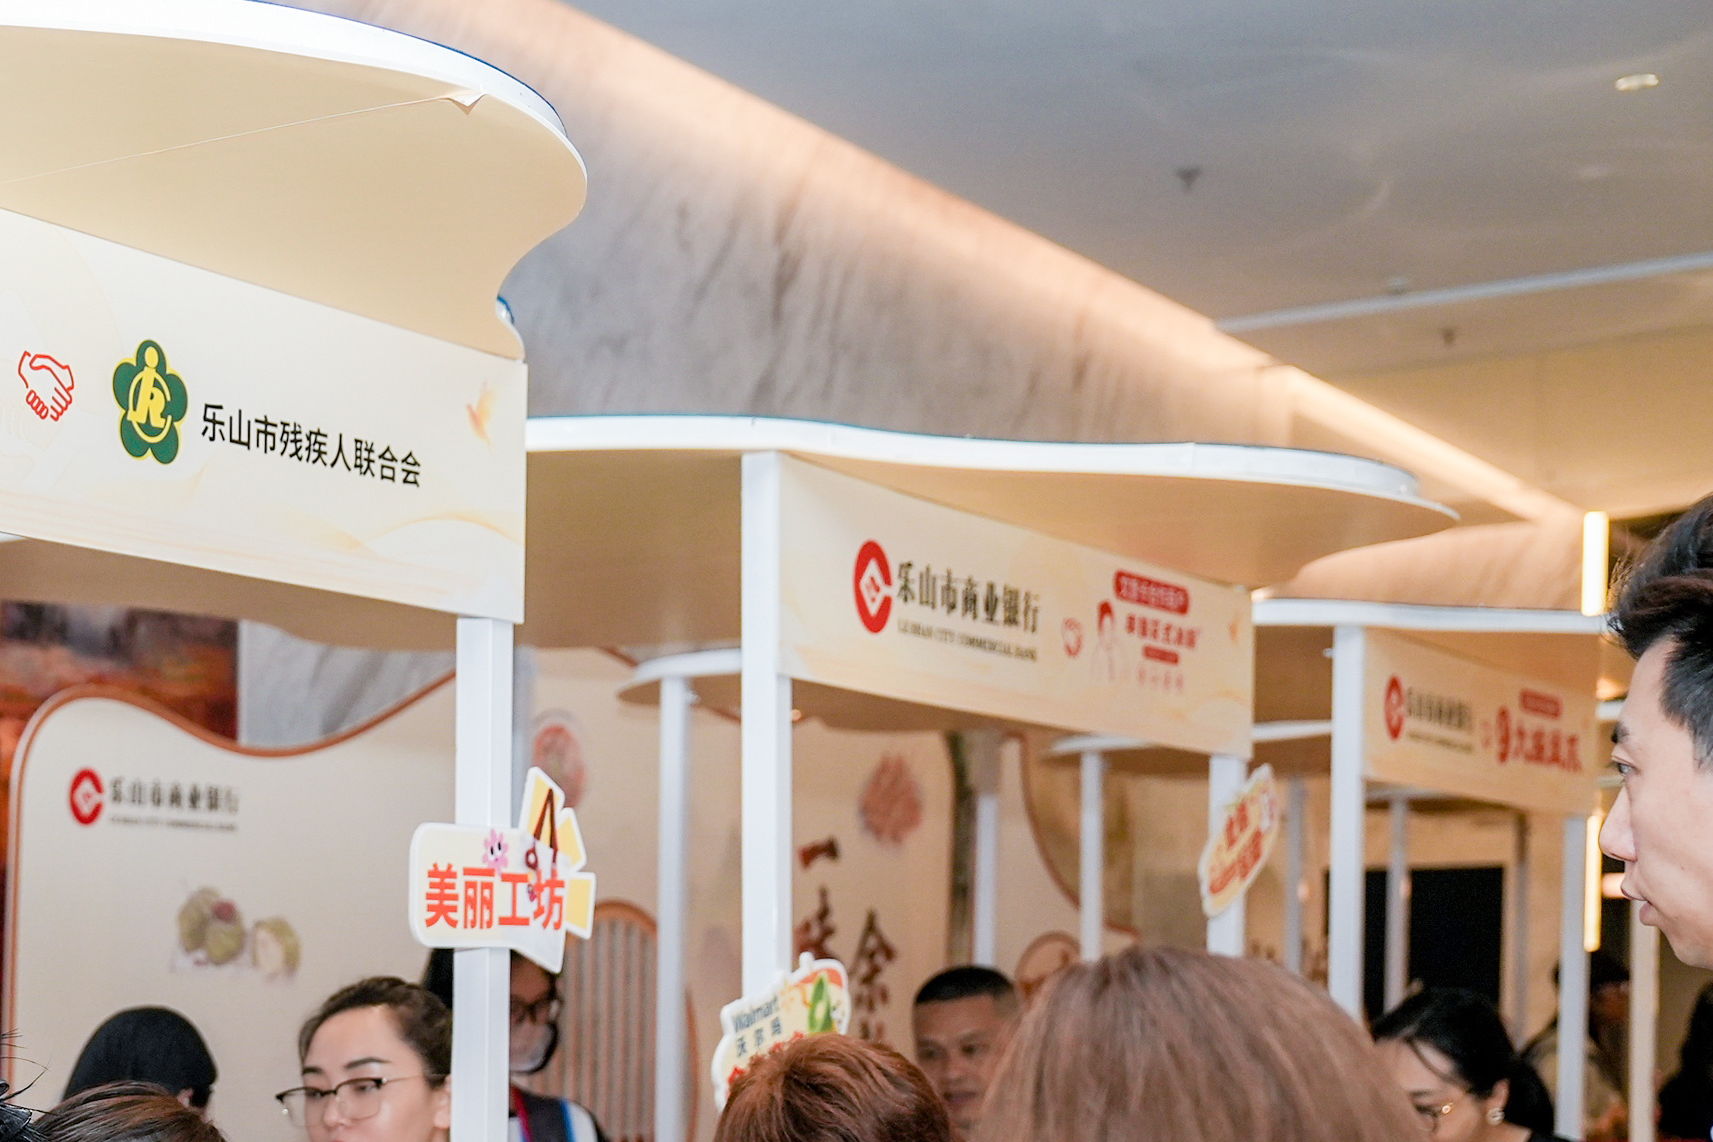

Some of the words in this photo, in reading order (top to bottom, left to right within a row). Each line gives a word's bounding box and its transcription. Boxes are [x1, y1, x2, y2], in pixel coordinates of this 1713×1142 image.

[200, 402, 422, 488] 乐山市残疾人联合会
[896, 560, 1040, 635] 乐山市商业银行
[424, 863, 566, 930] 美丽工坊
